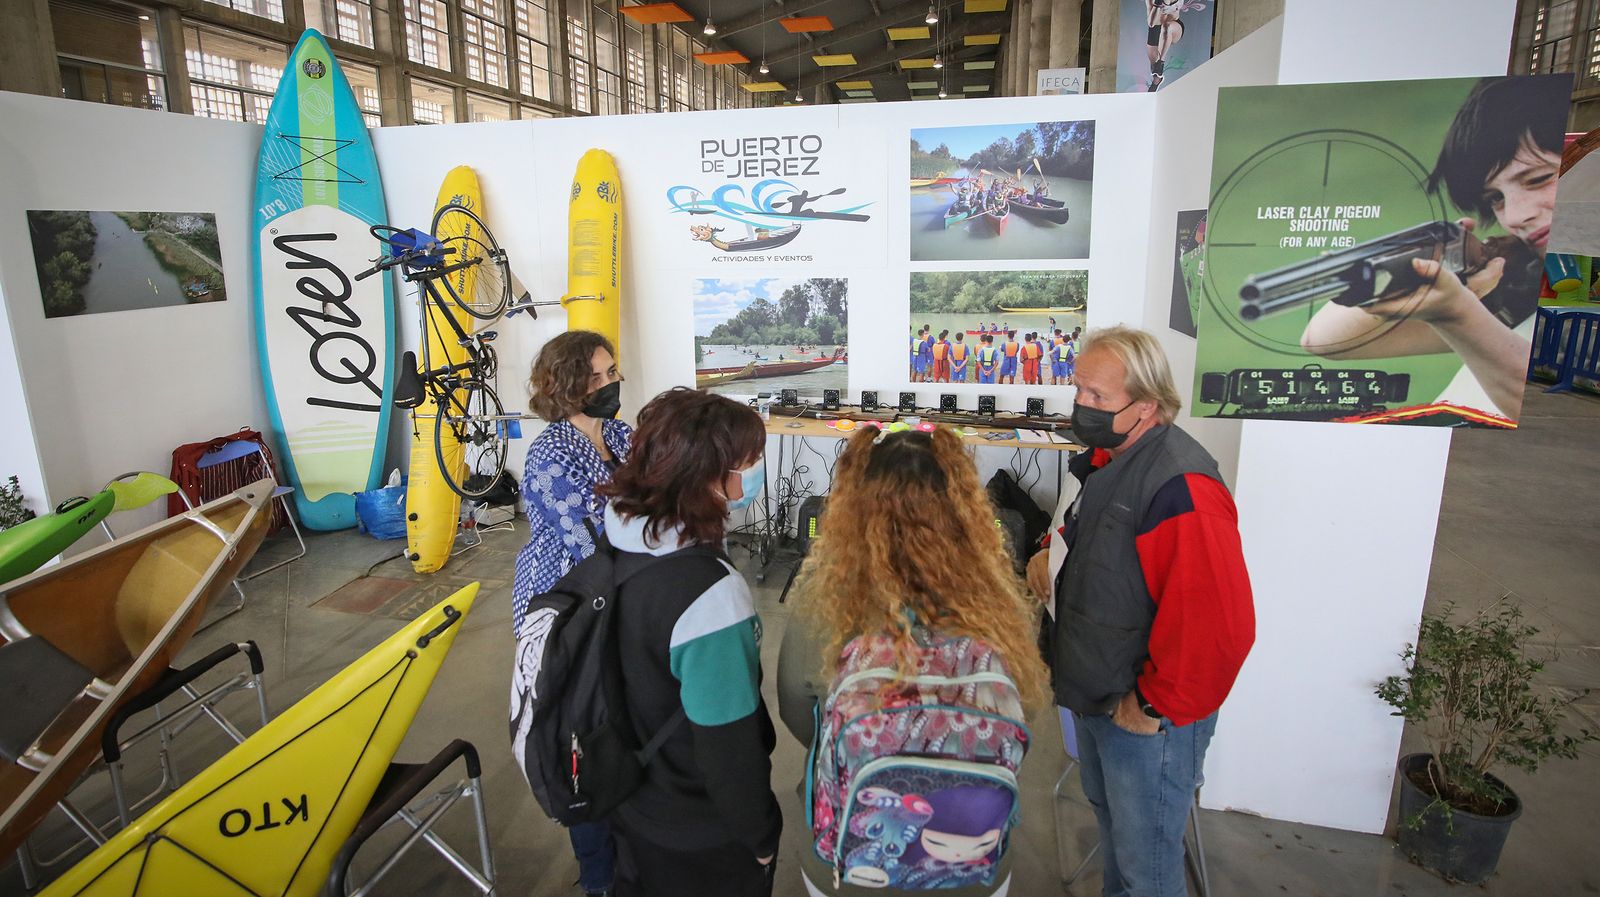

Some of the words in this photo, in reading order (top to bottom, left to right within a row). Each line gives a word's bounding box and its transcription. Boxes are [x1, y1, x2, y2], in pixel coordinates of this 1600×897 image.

[1041, 77, 1080, 88] IFECA
[700, 134, 823, 159] PUERTO
[701, 159, 725, 173] DE
[726, 156, 820, 179] JEREZ
[1257, 206, 1295, 219] LASER
[1299, 206, 1331, 219] CLAY
[1334, 205, 1381, 218] PIGEON
[1289, 219, 1350, 232] SHOOTING
[1280, 236, 1302, 248] (FOR
[1306, 236, 1328, 248] ANY
[1331, 236, 1355, 248] AGE)
[1259, 380, 1273, 394] 5
[1287, 380, 1296, 394] 1
[1314, 380, 1328, 394] 4
[1342, 380, 1355, 394] 6
[1369, 380, 1381, 394] 4
[219, 794, 308, 838] KTO
